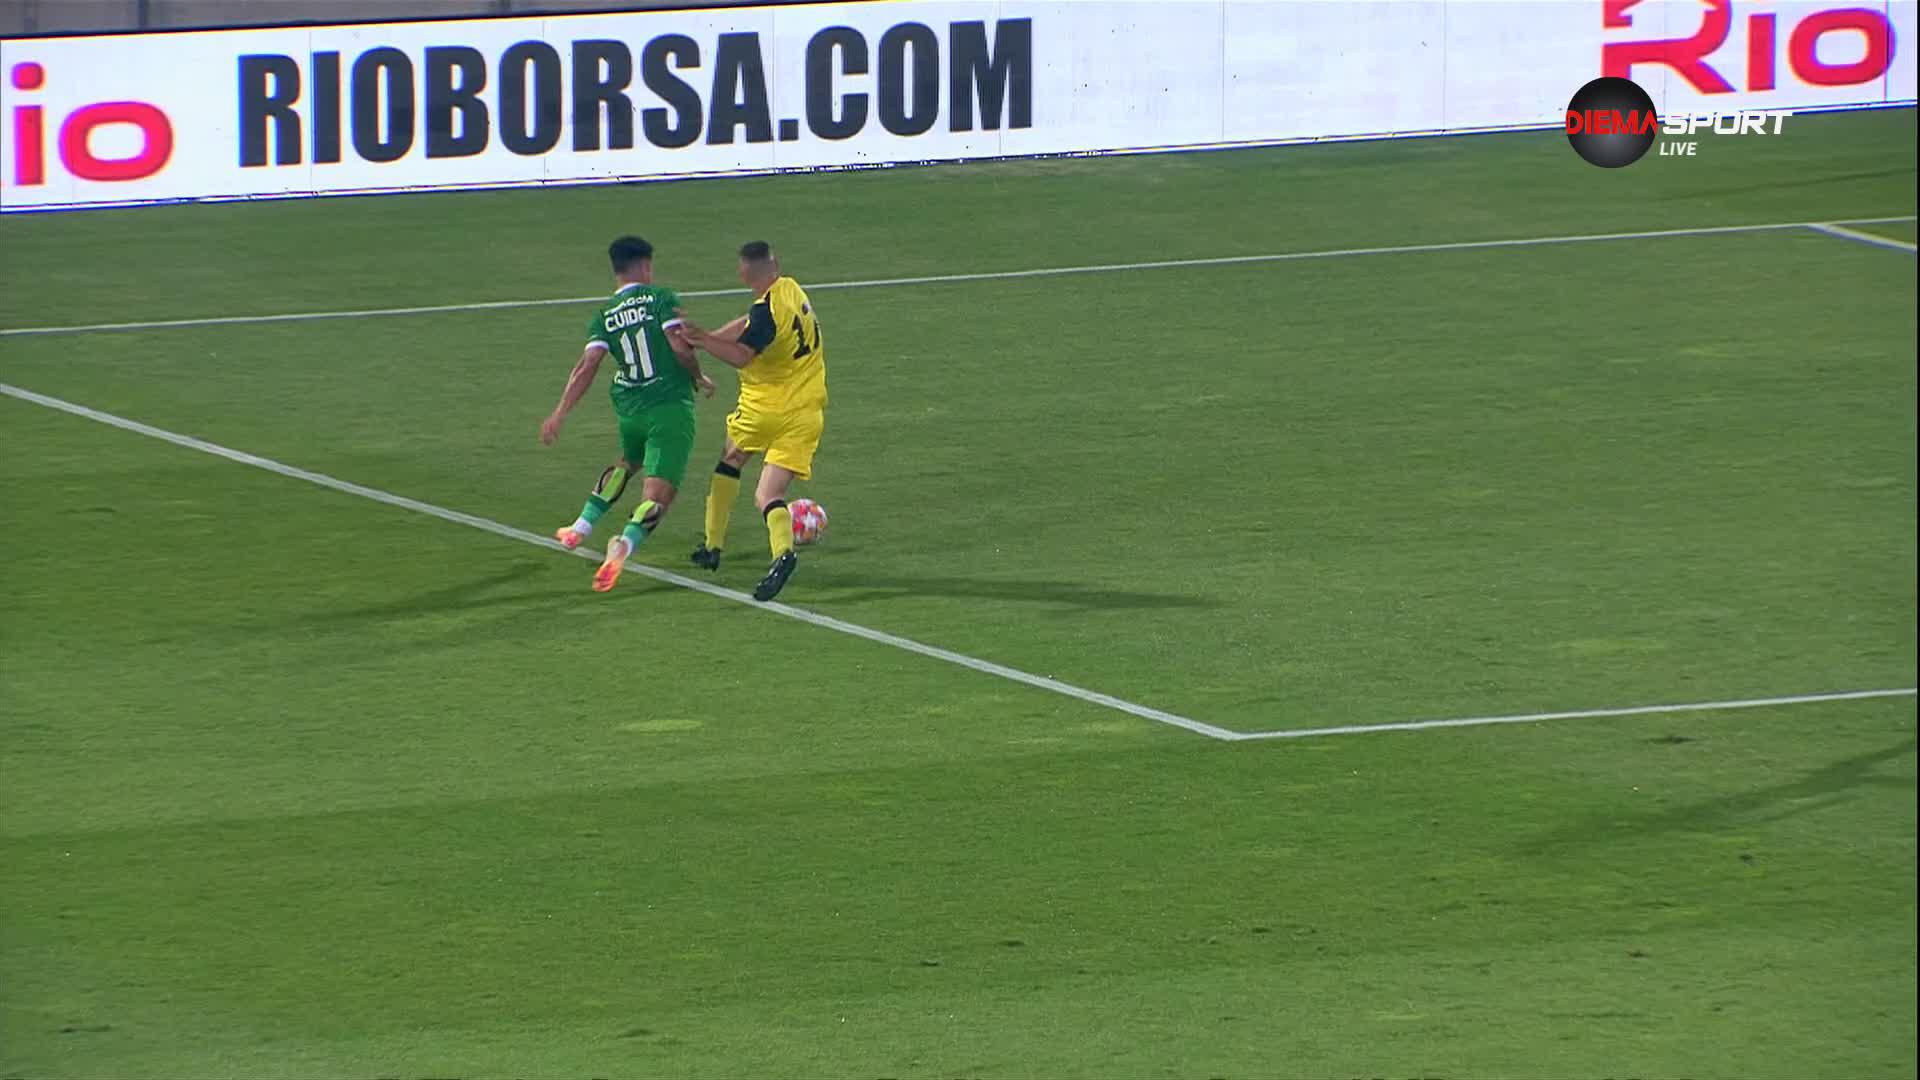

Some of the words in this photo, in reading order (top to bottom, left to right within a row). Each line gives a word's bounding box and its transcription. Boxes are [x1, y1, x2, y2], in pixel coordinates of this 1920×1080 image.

[11, 62, 173, 186] io
[238, 18, 1032, 168] RIOBORSA.COM
[620, 326, 654, 380] 11
